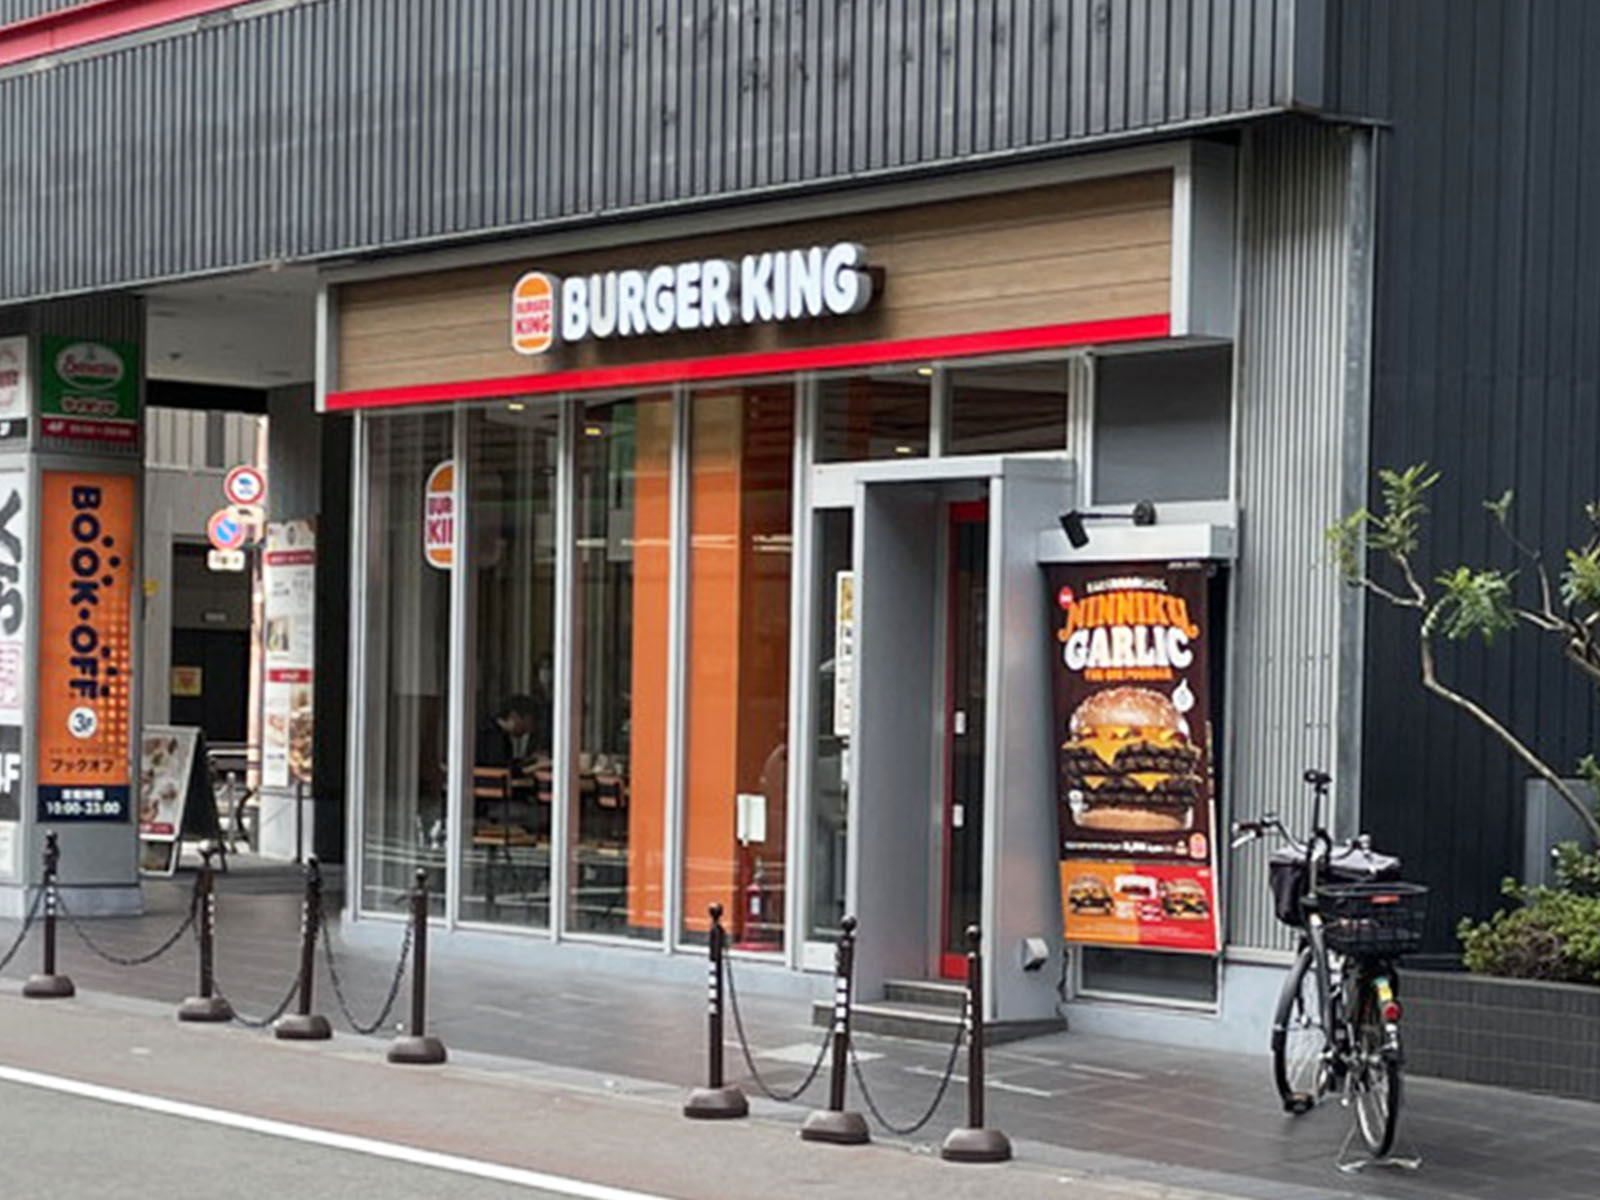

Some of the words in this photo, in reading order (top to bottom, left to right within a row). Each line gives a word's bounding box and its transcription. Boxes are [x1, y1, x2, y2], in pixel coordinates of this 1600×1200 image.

[561, 259, 732, 342] BURGER
[740, 242, 860, 323] KING
[515, 314, 550, 335] KING
[428, 518, 453, 544] KI
[1058, 591, 1199, 641] NINNIKU
[1064, 625, 1193, 671] GARLIC
